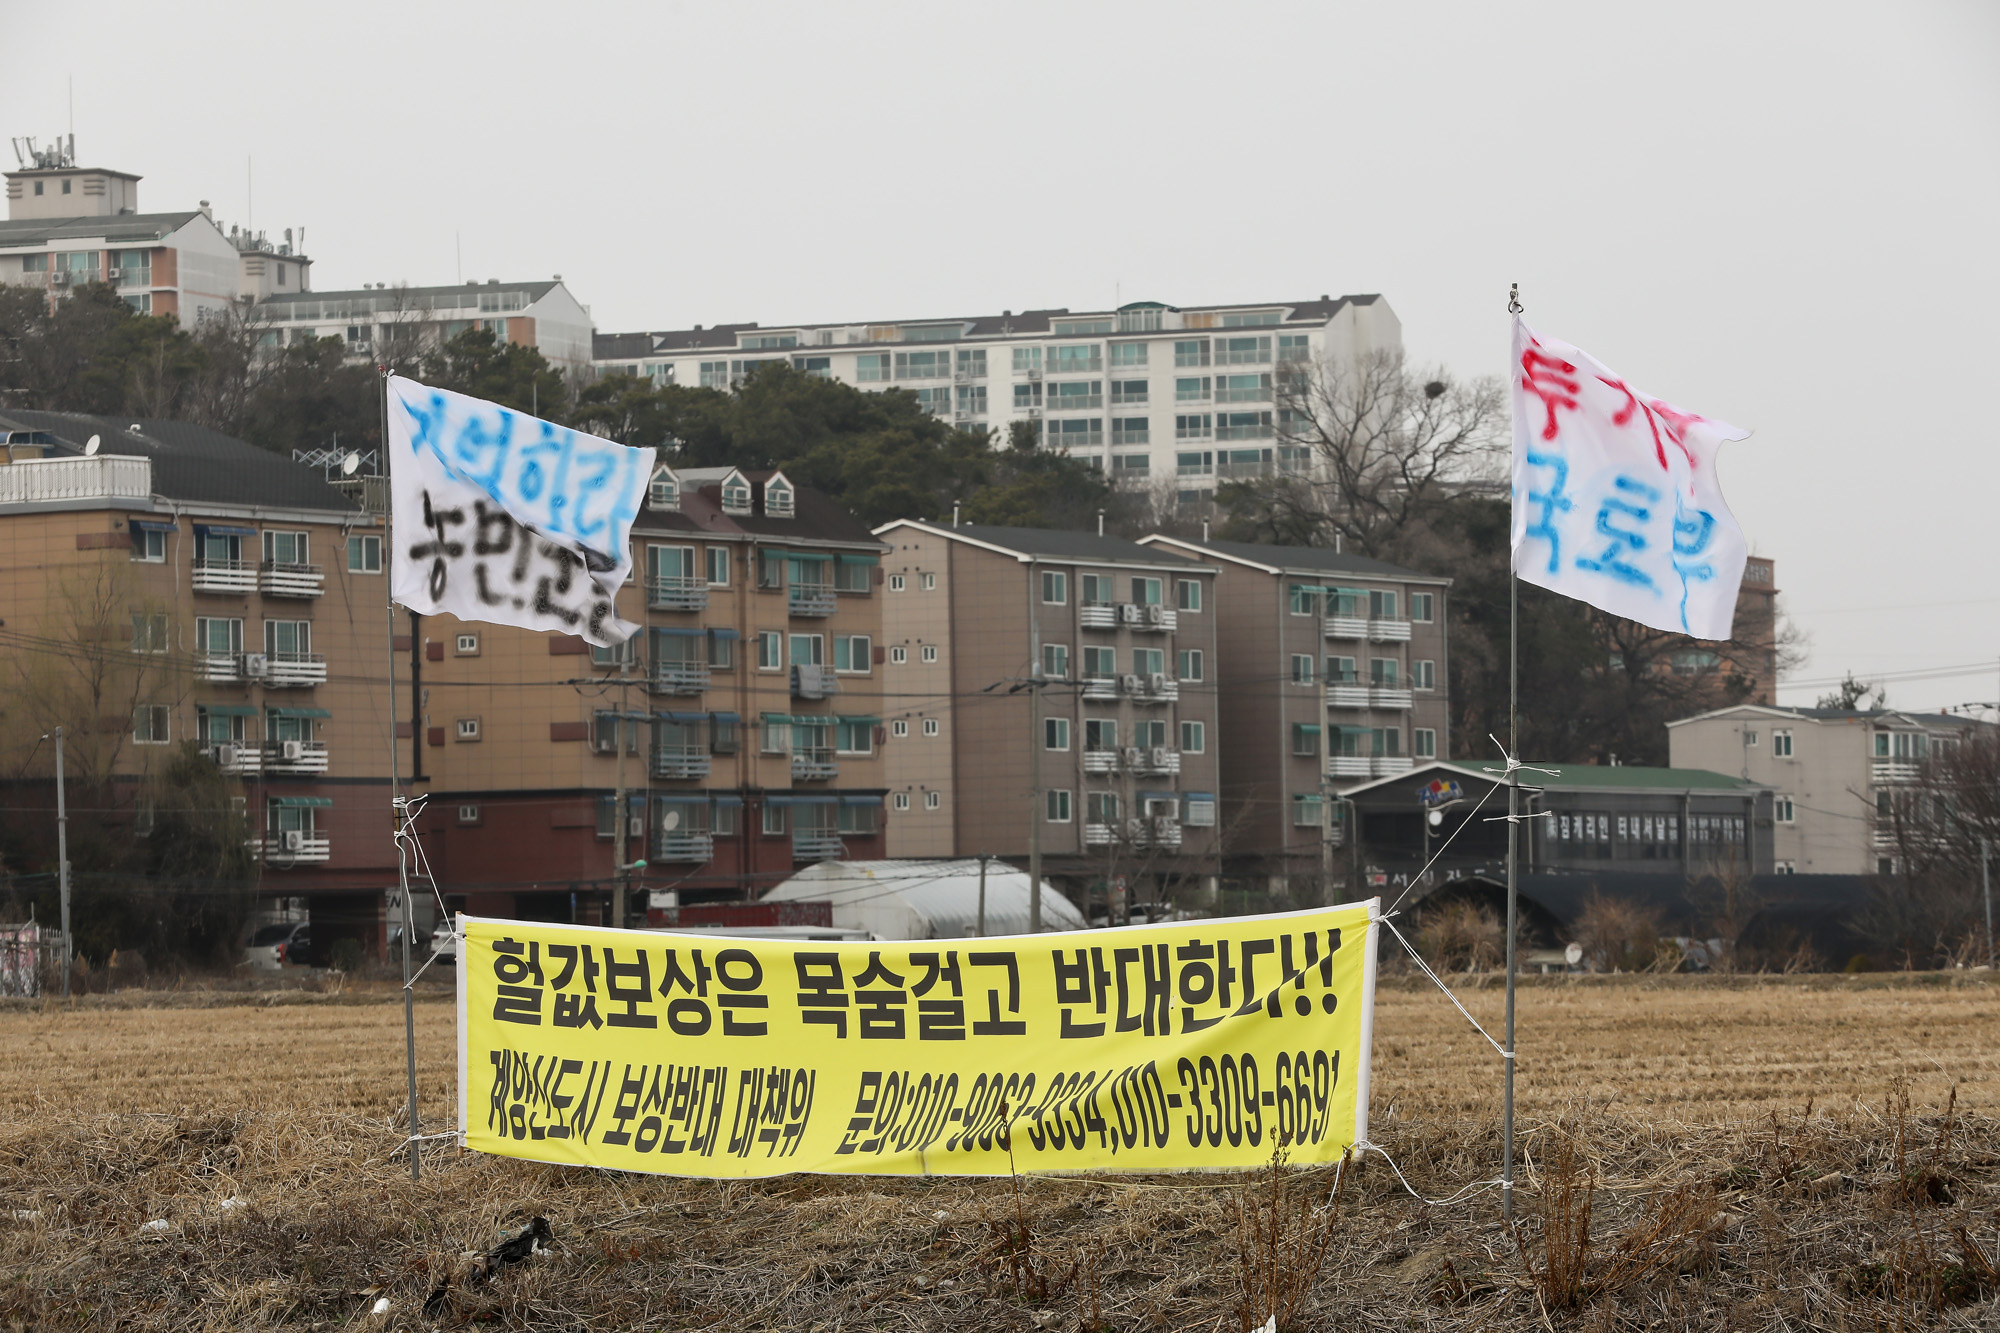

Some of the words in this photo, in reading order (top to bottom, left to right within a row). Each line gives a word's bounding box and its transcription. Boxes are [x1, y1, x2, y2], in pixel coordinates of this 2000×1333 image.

[491, 936, 769, 1037] 헐값보상은
[793, 948, 1027, 1041] 목숨걸고
[1051, 927, 1342, 1040] 반대한다!!
[488, 1048, 612, 1145] 계양신도시
[601, 1063, 728, 1159] 보상반대
[727, 1065, 817, 1159] 대책위
